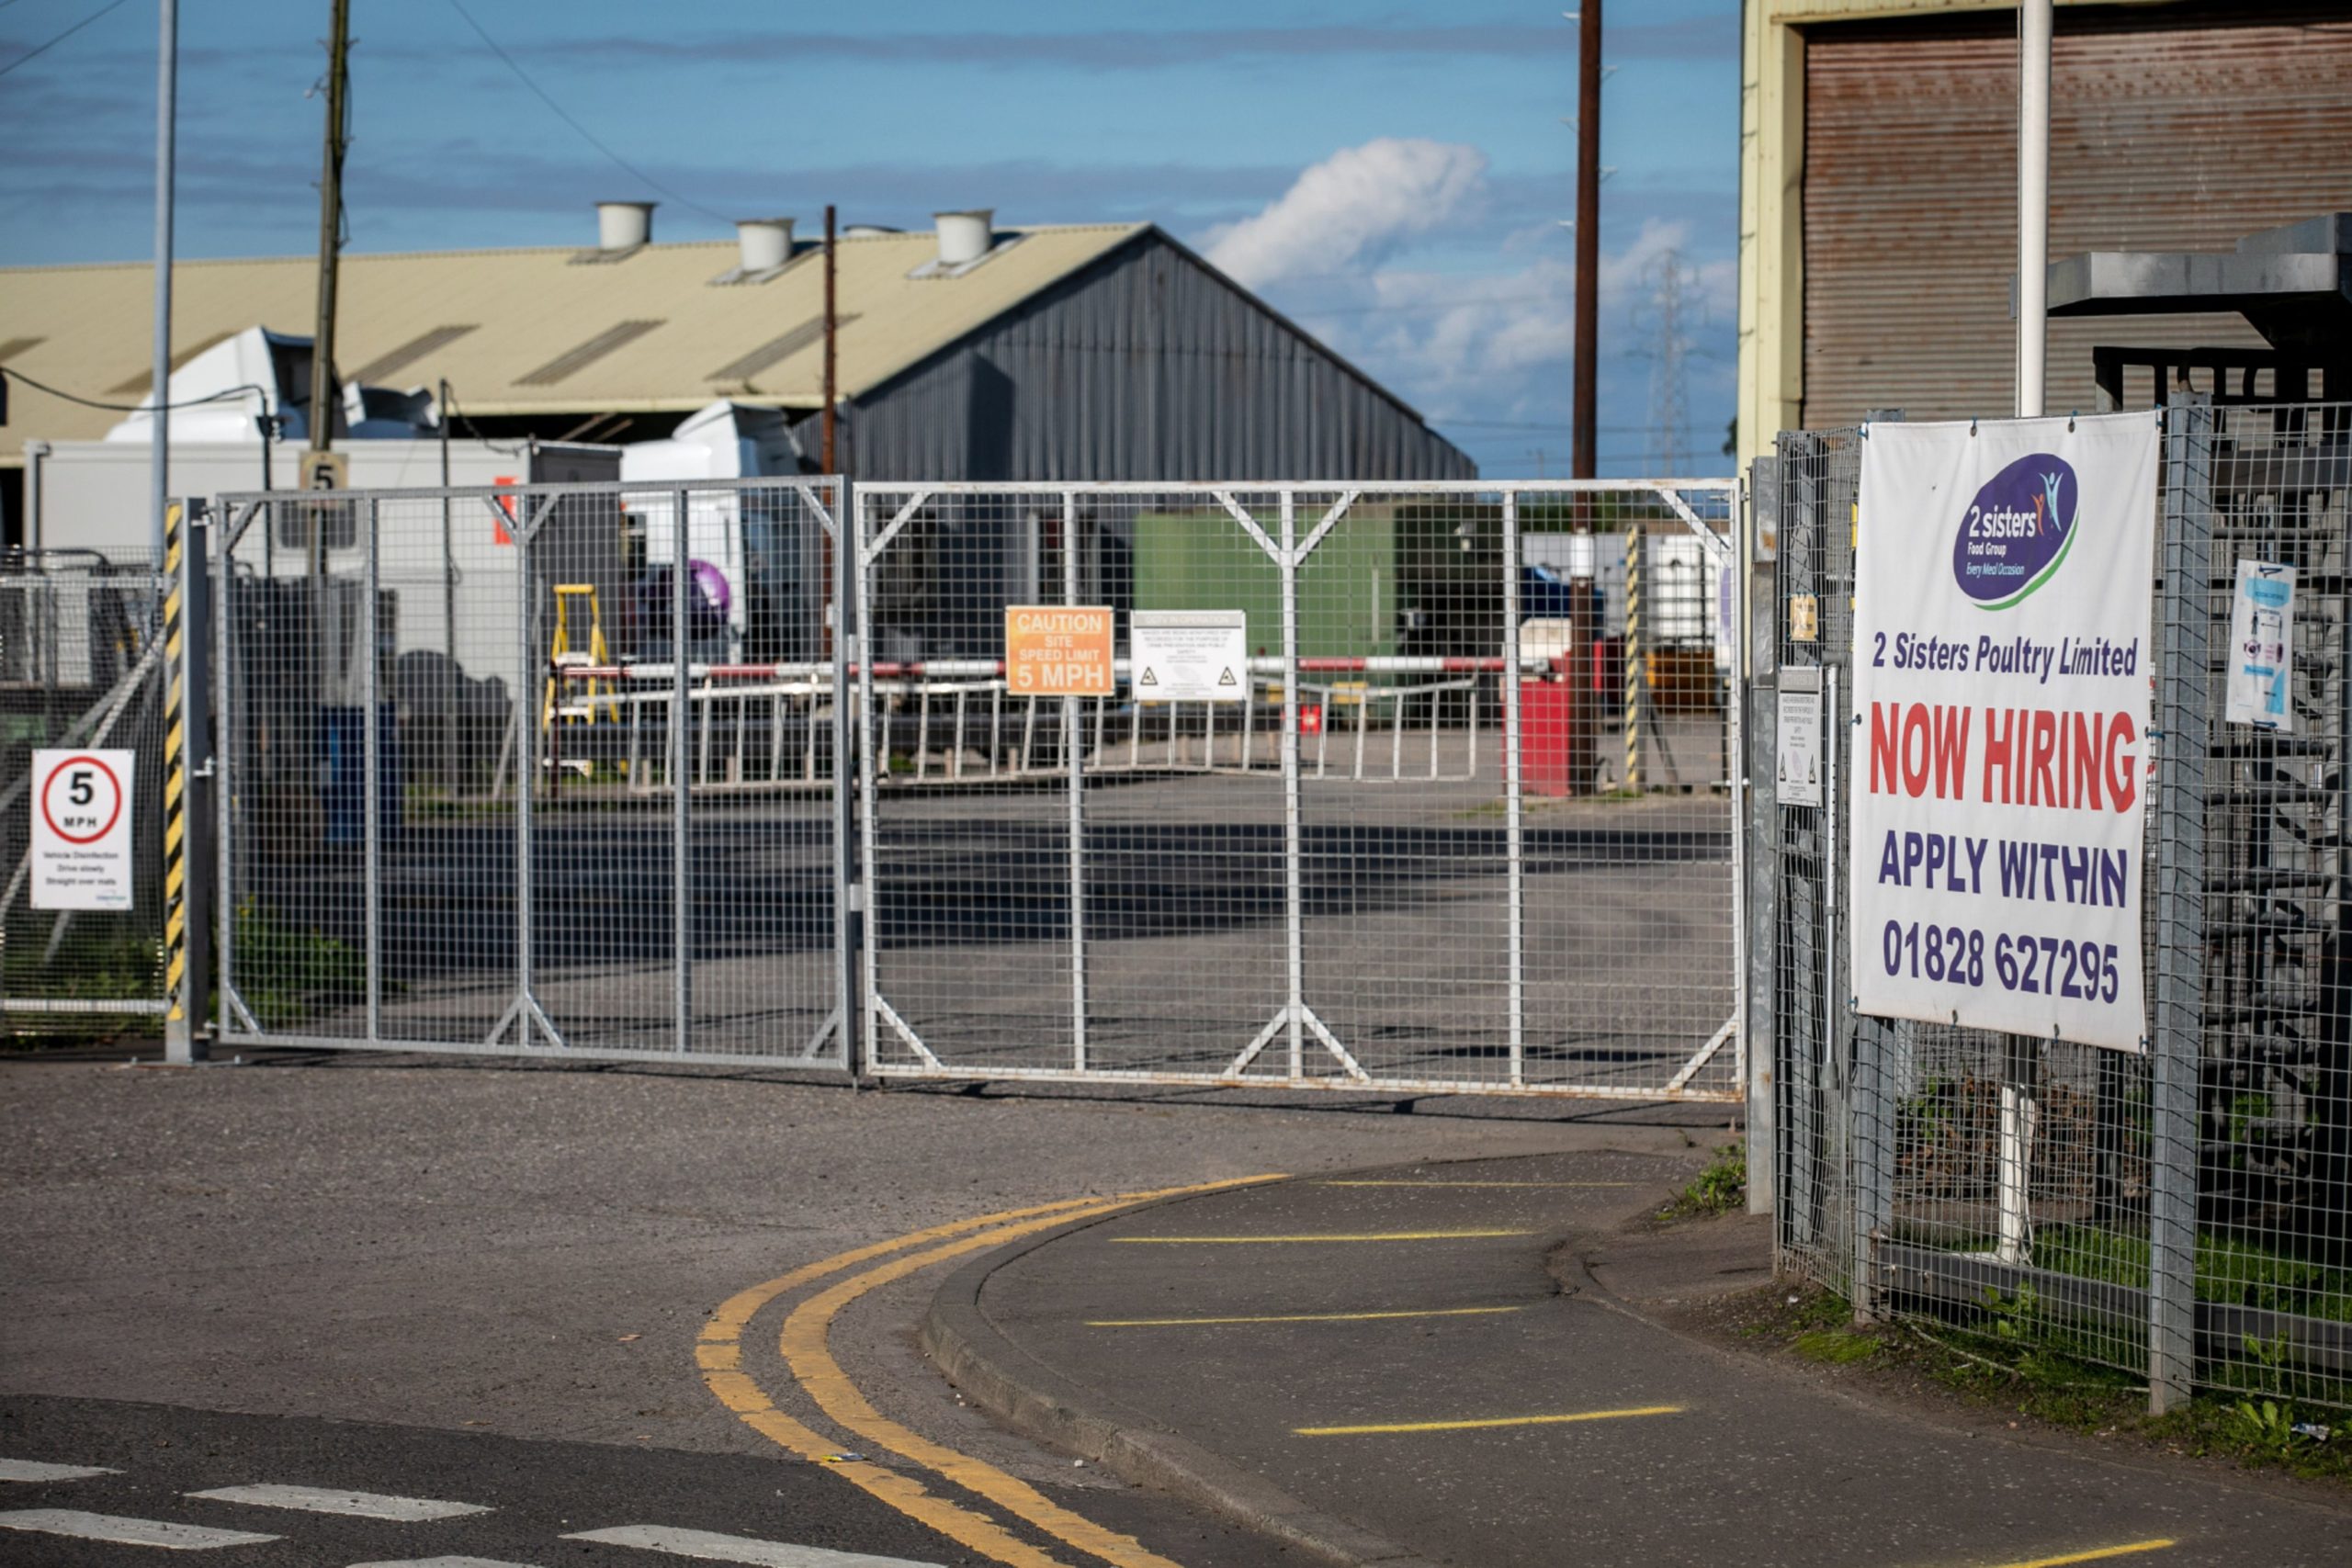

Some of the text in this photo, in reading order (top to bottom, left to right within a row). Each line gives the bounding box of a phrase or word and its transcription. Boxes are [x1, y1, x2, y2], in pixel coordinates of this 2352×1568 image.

[313, 465, 334, 490] 5
[1969, 505, 2037, 537] 2 sisters
[1967, 542, 2007, 558] Food Group
[1966, 562, 2024, 578] Every Meal Occasion
[1017, 614, 1102, 632] CAUTION
[1045, 636, 1073, 648] SITE
[1019, 649, 1100, 661] SPEED LIMIT
[1872, 631, 2138, 684] 2 Sisters Poultry Limited
[1017, 663, 1103, 688] 5 MPH
[1871, 701, 2136, 814] NOW HIRING
[69, 771, 94, 806] 5
[63, 818, 97, 828] MPH
[1878, 829, 2127, 908] APPLY WITHIN
[1883, 919, 2119, 1004] 01828 627295
